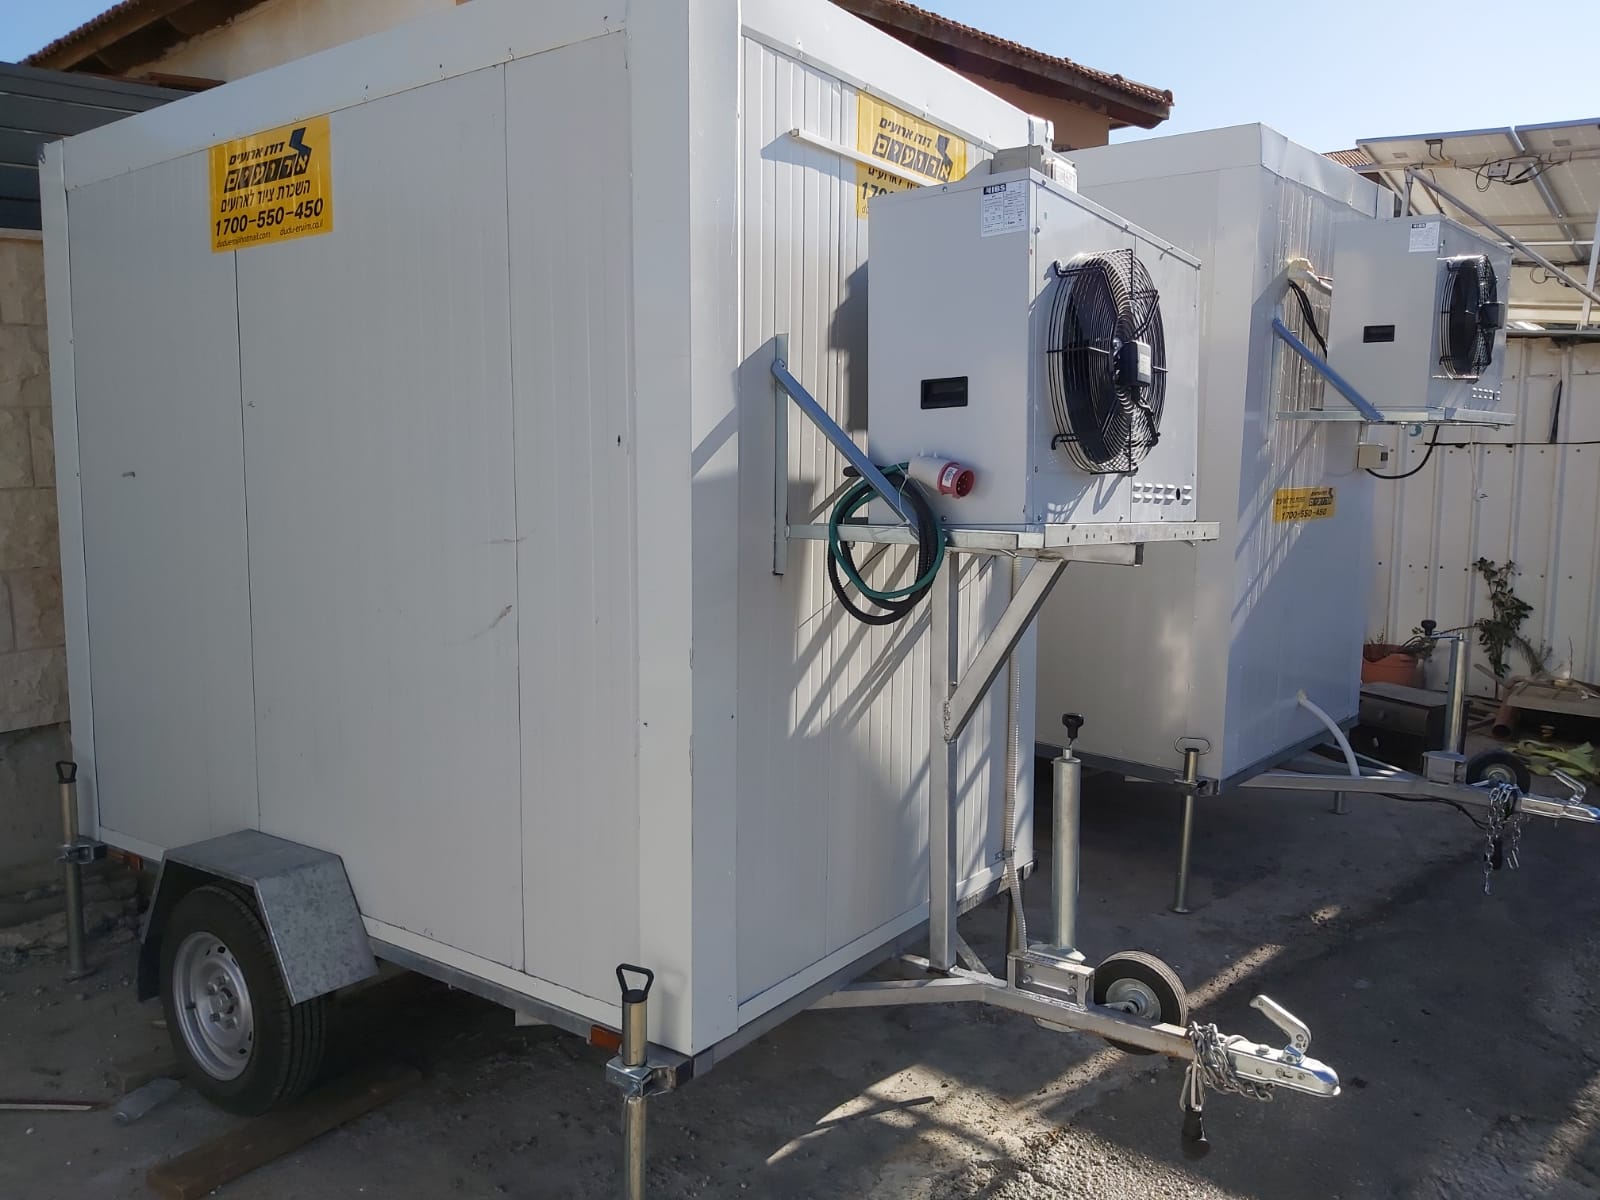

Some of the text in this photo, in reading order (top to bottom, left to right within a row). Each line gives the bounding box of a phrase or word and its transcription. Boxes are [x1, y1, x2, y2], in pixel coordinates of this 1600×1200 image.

[879, 117, 933, 148] דודו ארועים
[229, 142, 286, 166] דודו ארועים
[872, 132, 954, 183] ארועים
[224, 153, 311, 194] ארועים
[220, 180, 311, 213] השכרת ציוד לארועים
[215, 198, 324, 237] 1700-550-450
